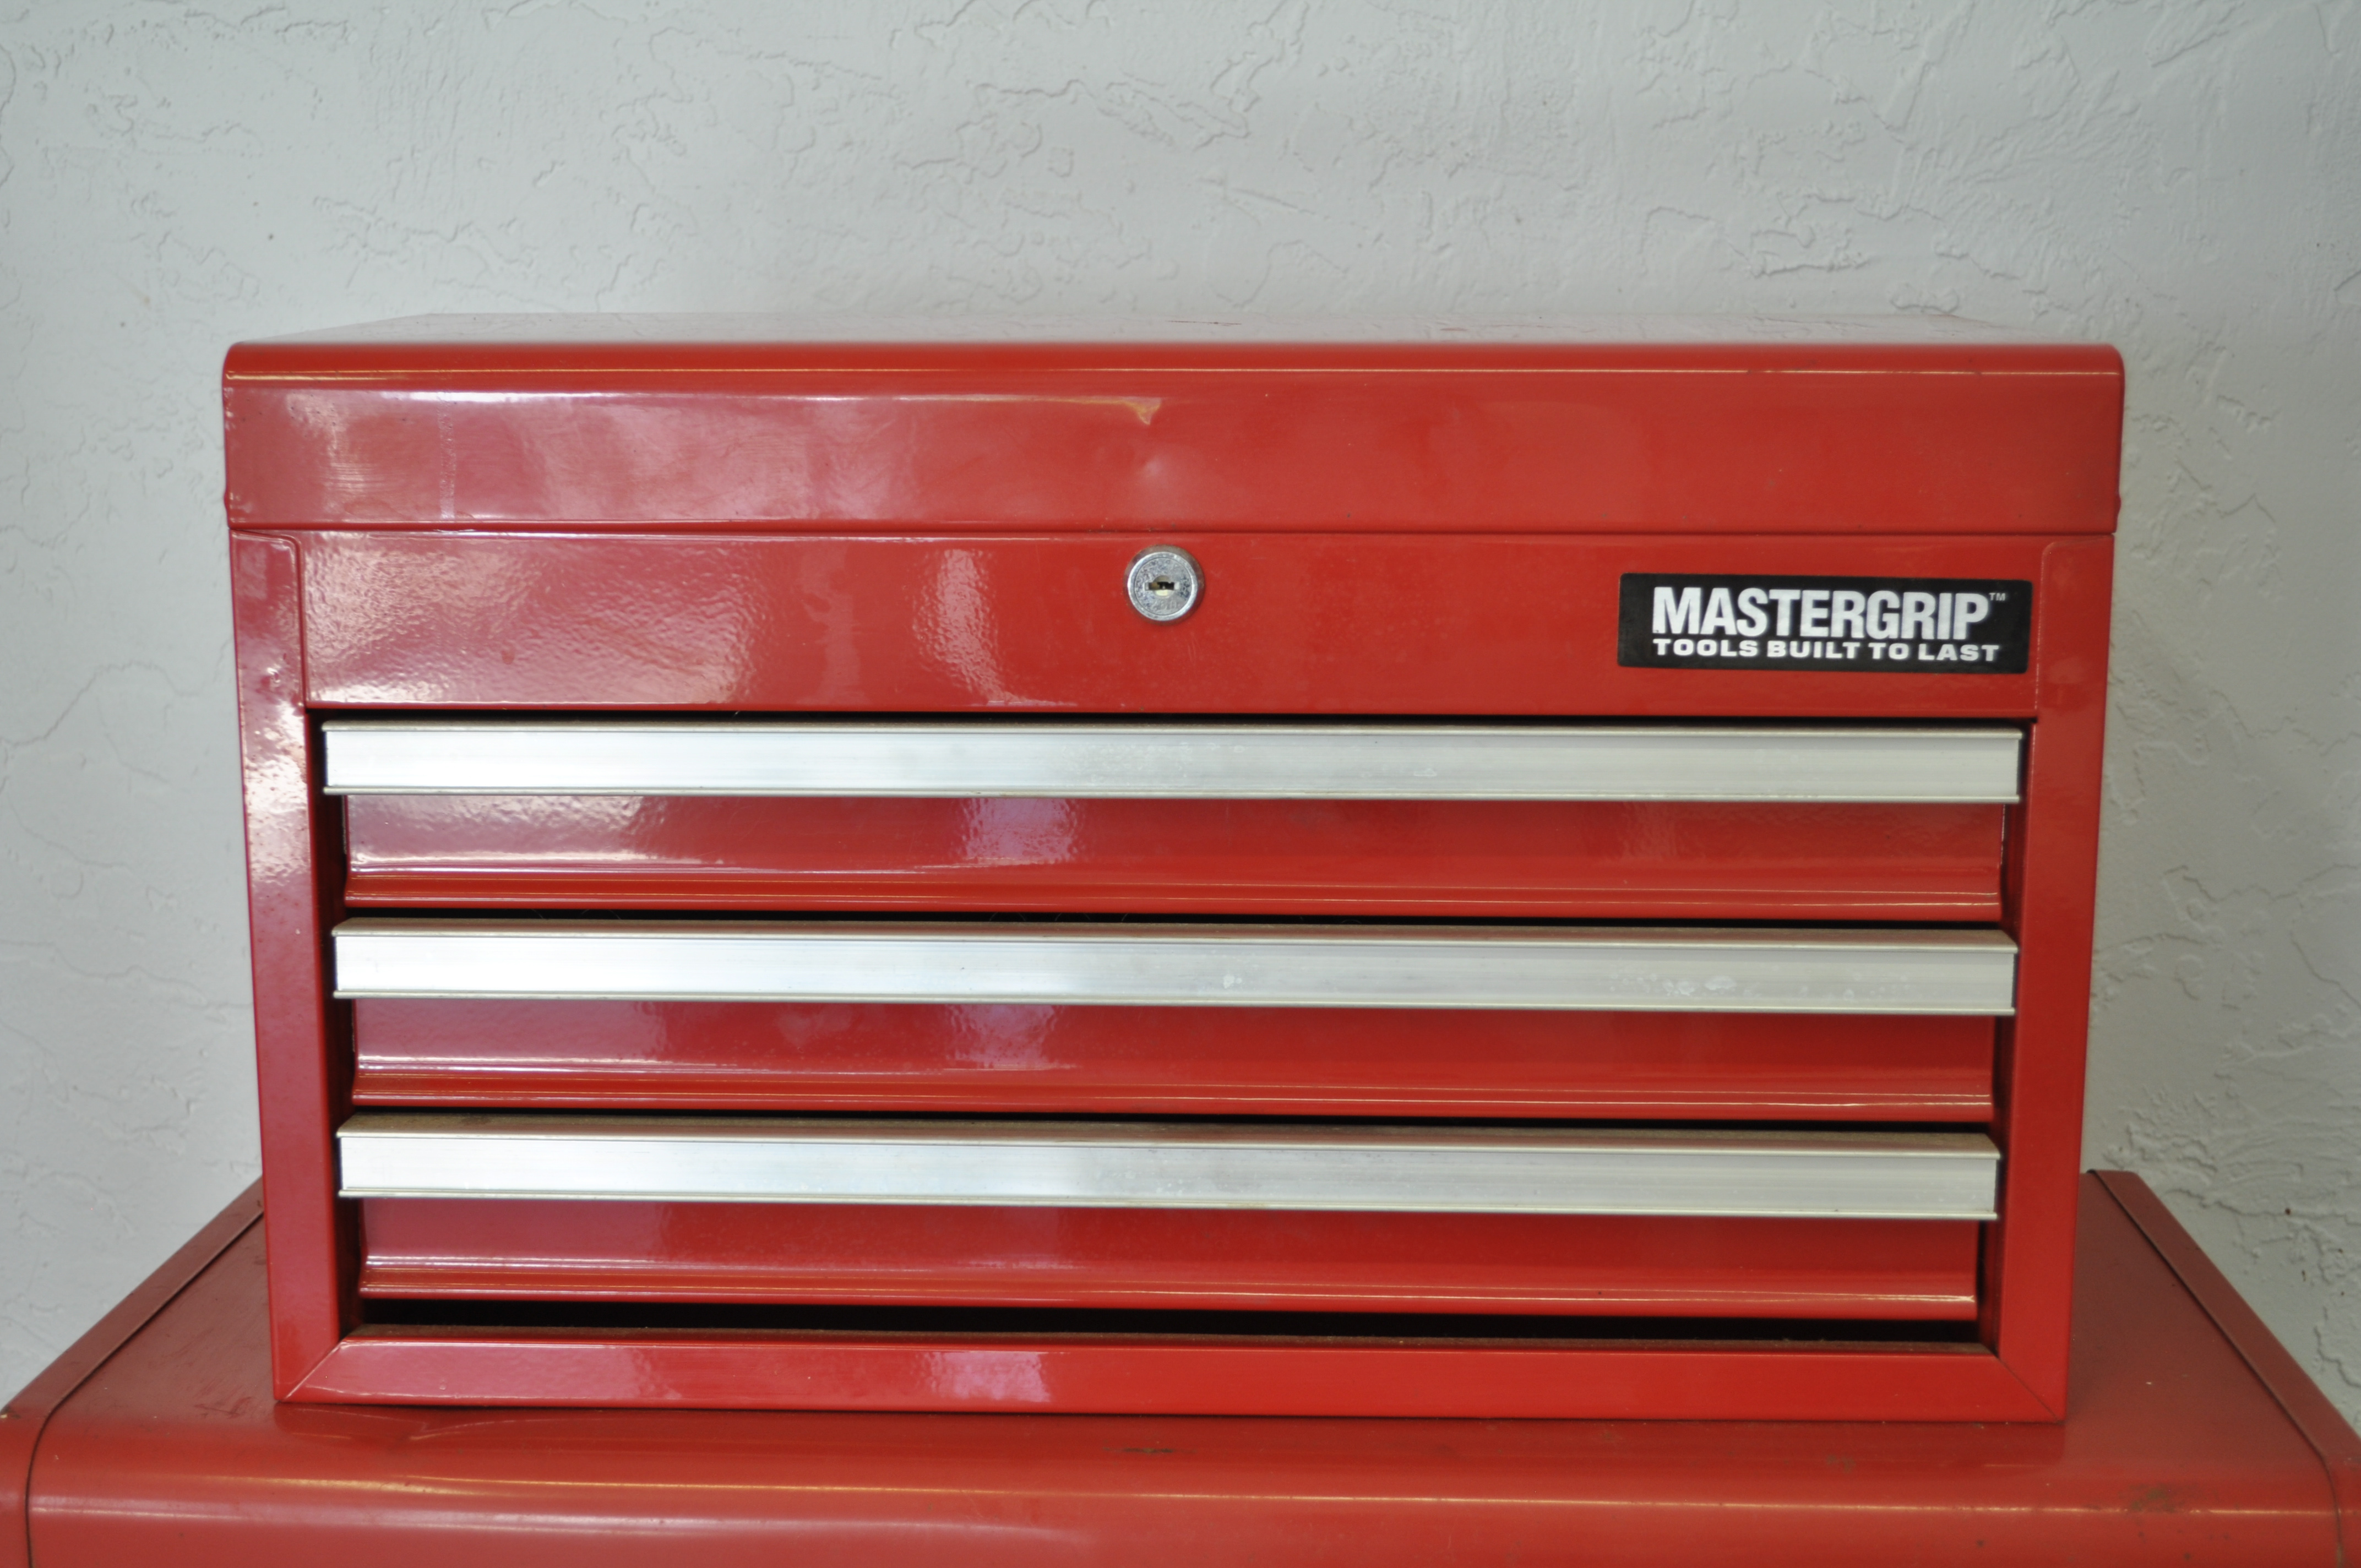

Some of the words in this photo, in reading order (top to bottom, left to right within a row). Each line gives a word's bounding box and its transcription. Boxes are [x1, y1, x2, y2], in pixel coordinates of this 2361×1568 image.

[1652, 586, 1989, 640] MASTERGRIP
[1652, 638, 1760, 657] TOOLS
[1766, 640, 1861, 660] BUILT
[1868, 642, 1911, 661] TO
[1918, 643, 2000, 662] LAST
